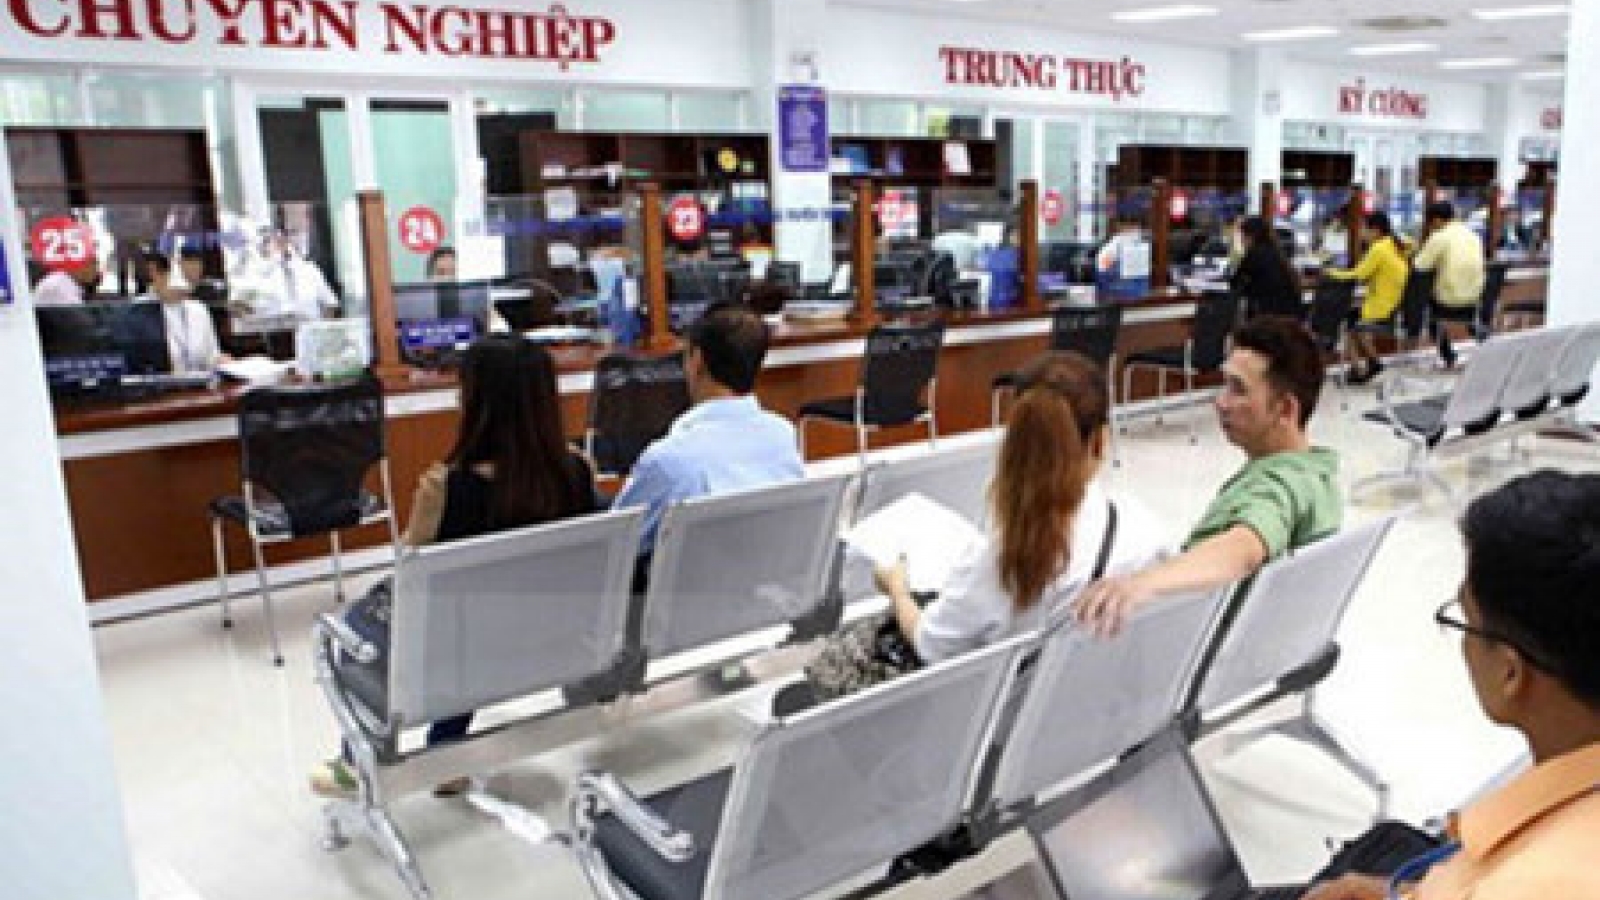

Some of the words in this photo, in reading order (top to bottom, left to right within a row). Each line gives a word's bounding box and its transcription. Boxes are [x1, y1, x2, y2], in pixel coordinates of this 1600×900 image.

[379, 2, 615, 71] NGHIỆP
[939, 45, 1056, 90] TRUNG
[1063, 55, 1145, 102] THỰC
[40, 228, 87, 262] 25
[406, 215, 437, 245] 24
